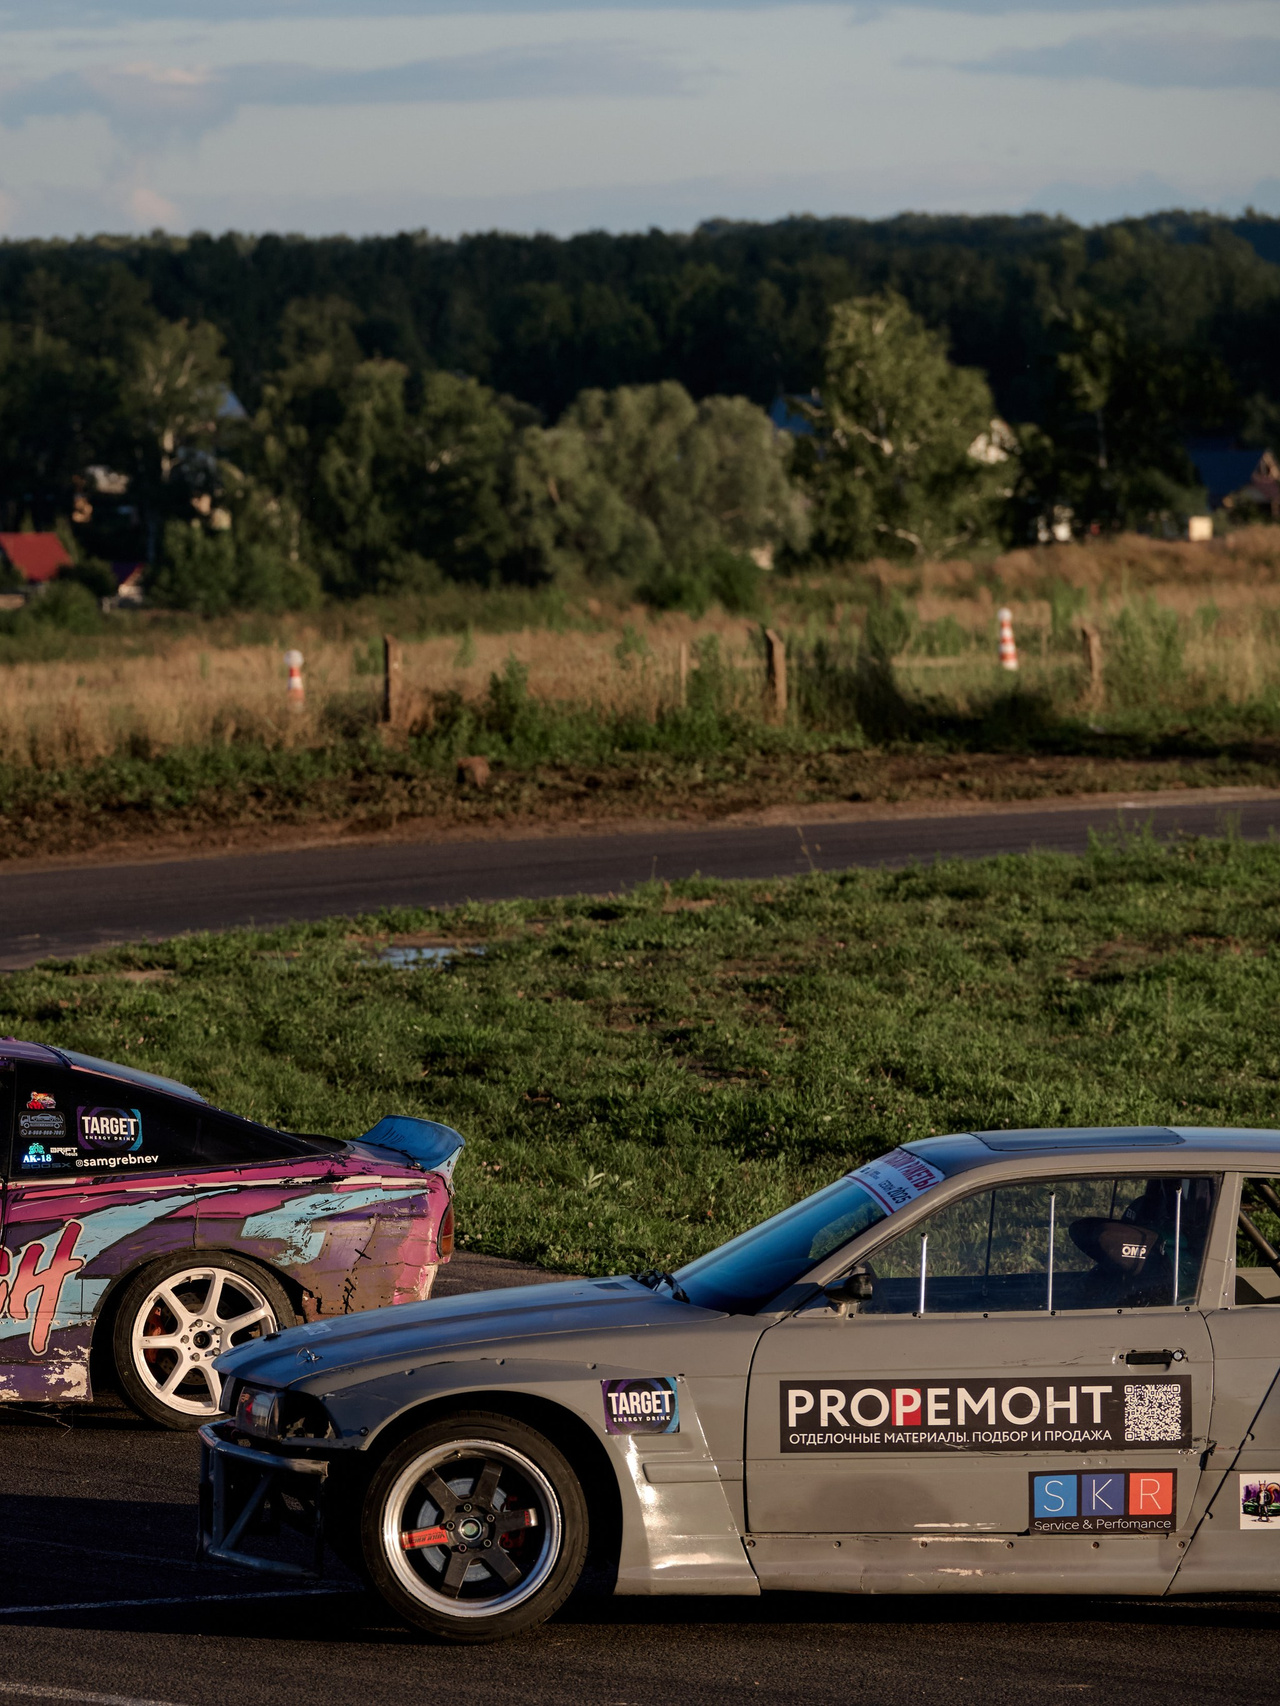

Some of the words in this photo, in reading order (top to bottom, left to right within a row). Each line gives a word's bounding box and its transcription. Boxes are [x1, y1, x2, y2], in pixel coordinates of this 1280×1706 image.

[81, 1115, 139, 1136] TARGET
[22, 1153, 52, 1163] AK-18
[887, 1187, 912, 1204] 2025
[1121, 1245, 1147, 1258] OMP
[607, 1390, 674, 1415] TARGET
[789, 1432, 881, 1446] ОТДЕЛОЧНЫЕ
[884, 1432, 969, 1445] МАТЕРИАЛЫ.
[972, 1431, 1029, 1445] ПОДБОР
[1031, 1431, 1041, 1442] И
[1044, 1429, 1113, 1443] ПРОДАЖА
[1034, 1519, 1080, 1531] Service
[1082, 1519, 1093, 1530] &
[1096, 1517, 1172, 1530] Perfomance
